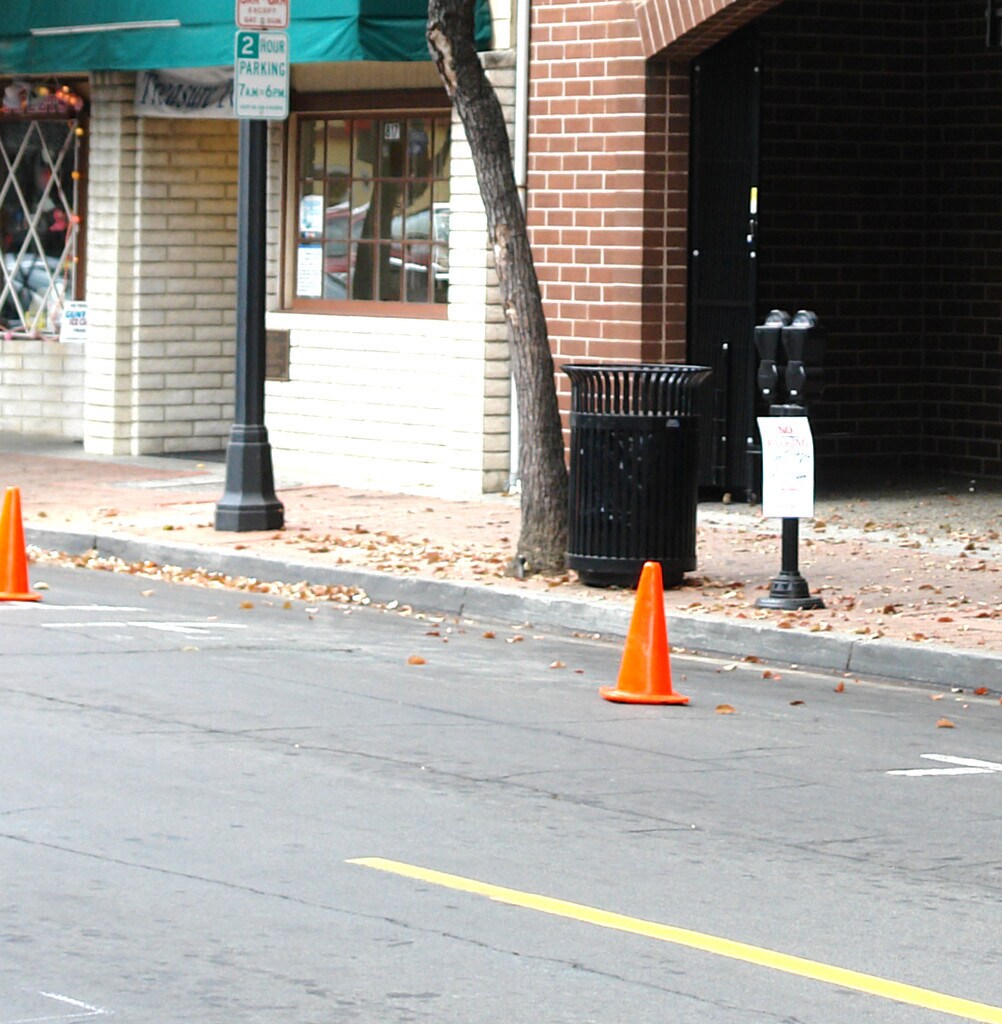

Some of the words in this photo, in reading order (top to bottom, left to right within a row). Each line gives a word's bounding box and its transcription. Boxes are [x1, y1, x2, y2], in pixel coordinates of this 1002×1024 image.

[241, 36, 254, 55] 2
[260, 39, 285, 53] HOUR
[240, 61, 285, 77] PARKING
[239, 83, 258, 97] 7AM
[265, 84, 285, 98] 6PM
